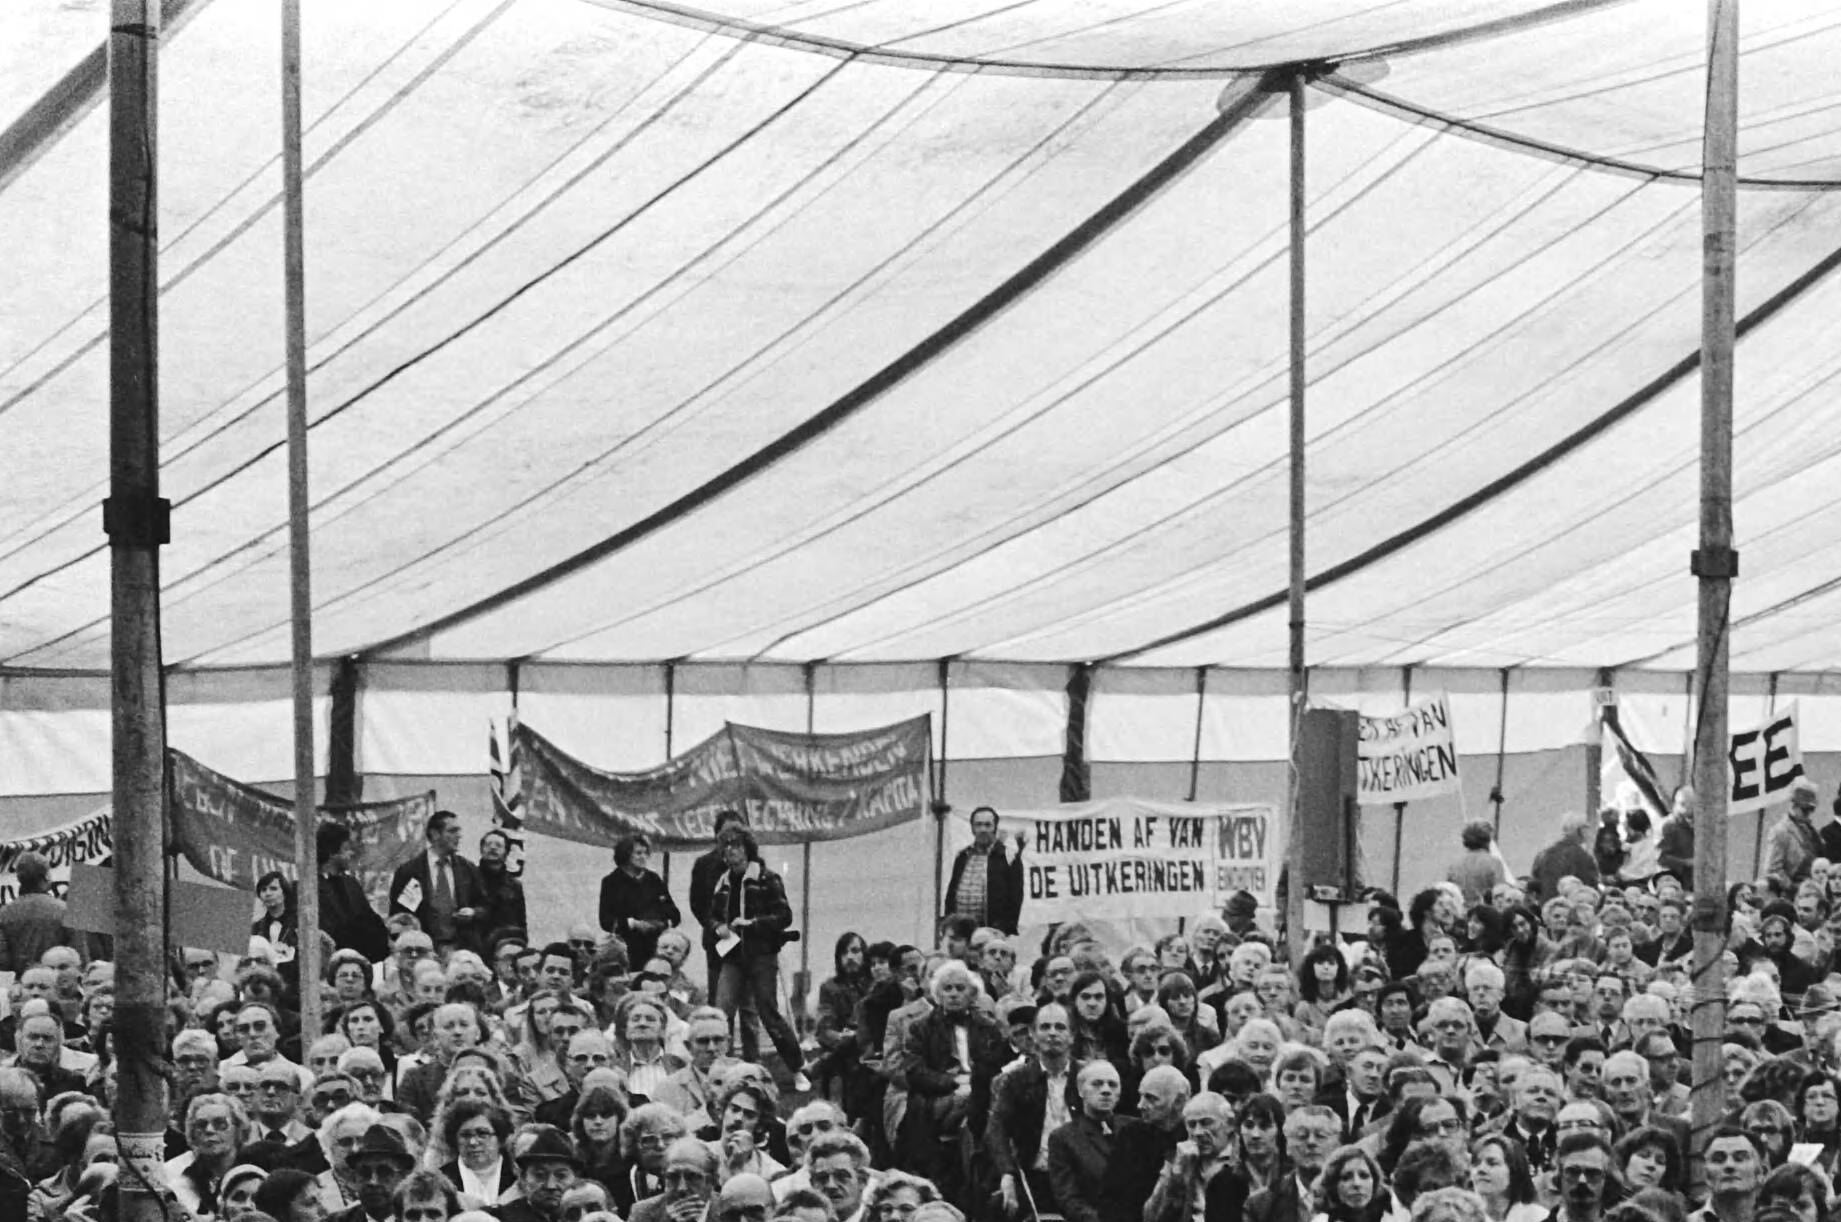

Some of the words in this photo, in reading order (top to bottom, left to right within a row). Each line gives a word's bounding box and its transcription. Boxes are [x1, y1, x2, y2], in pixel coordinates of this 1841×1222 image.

[1036, 817, 1122, 853] HANDEN
[1134, 816, 1157, 848] AF
[1169, 816, 1204, 848] VAN
[1217, 815, 1267, 860] WBV
[1030, 866, 1058, 899] DE
[1068, 860, 1204, 897] UITKERINGEN
